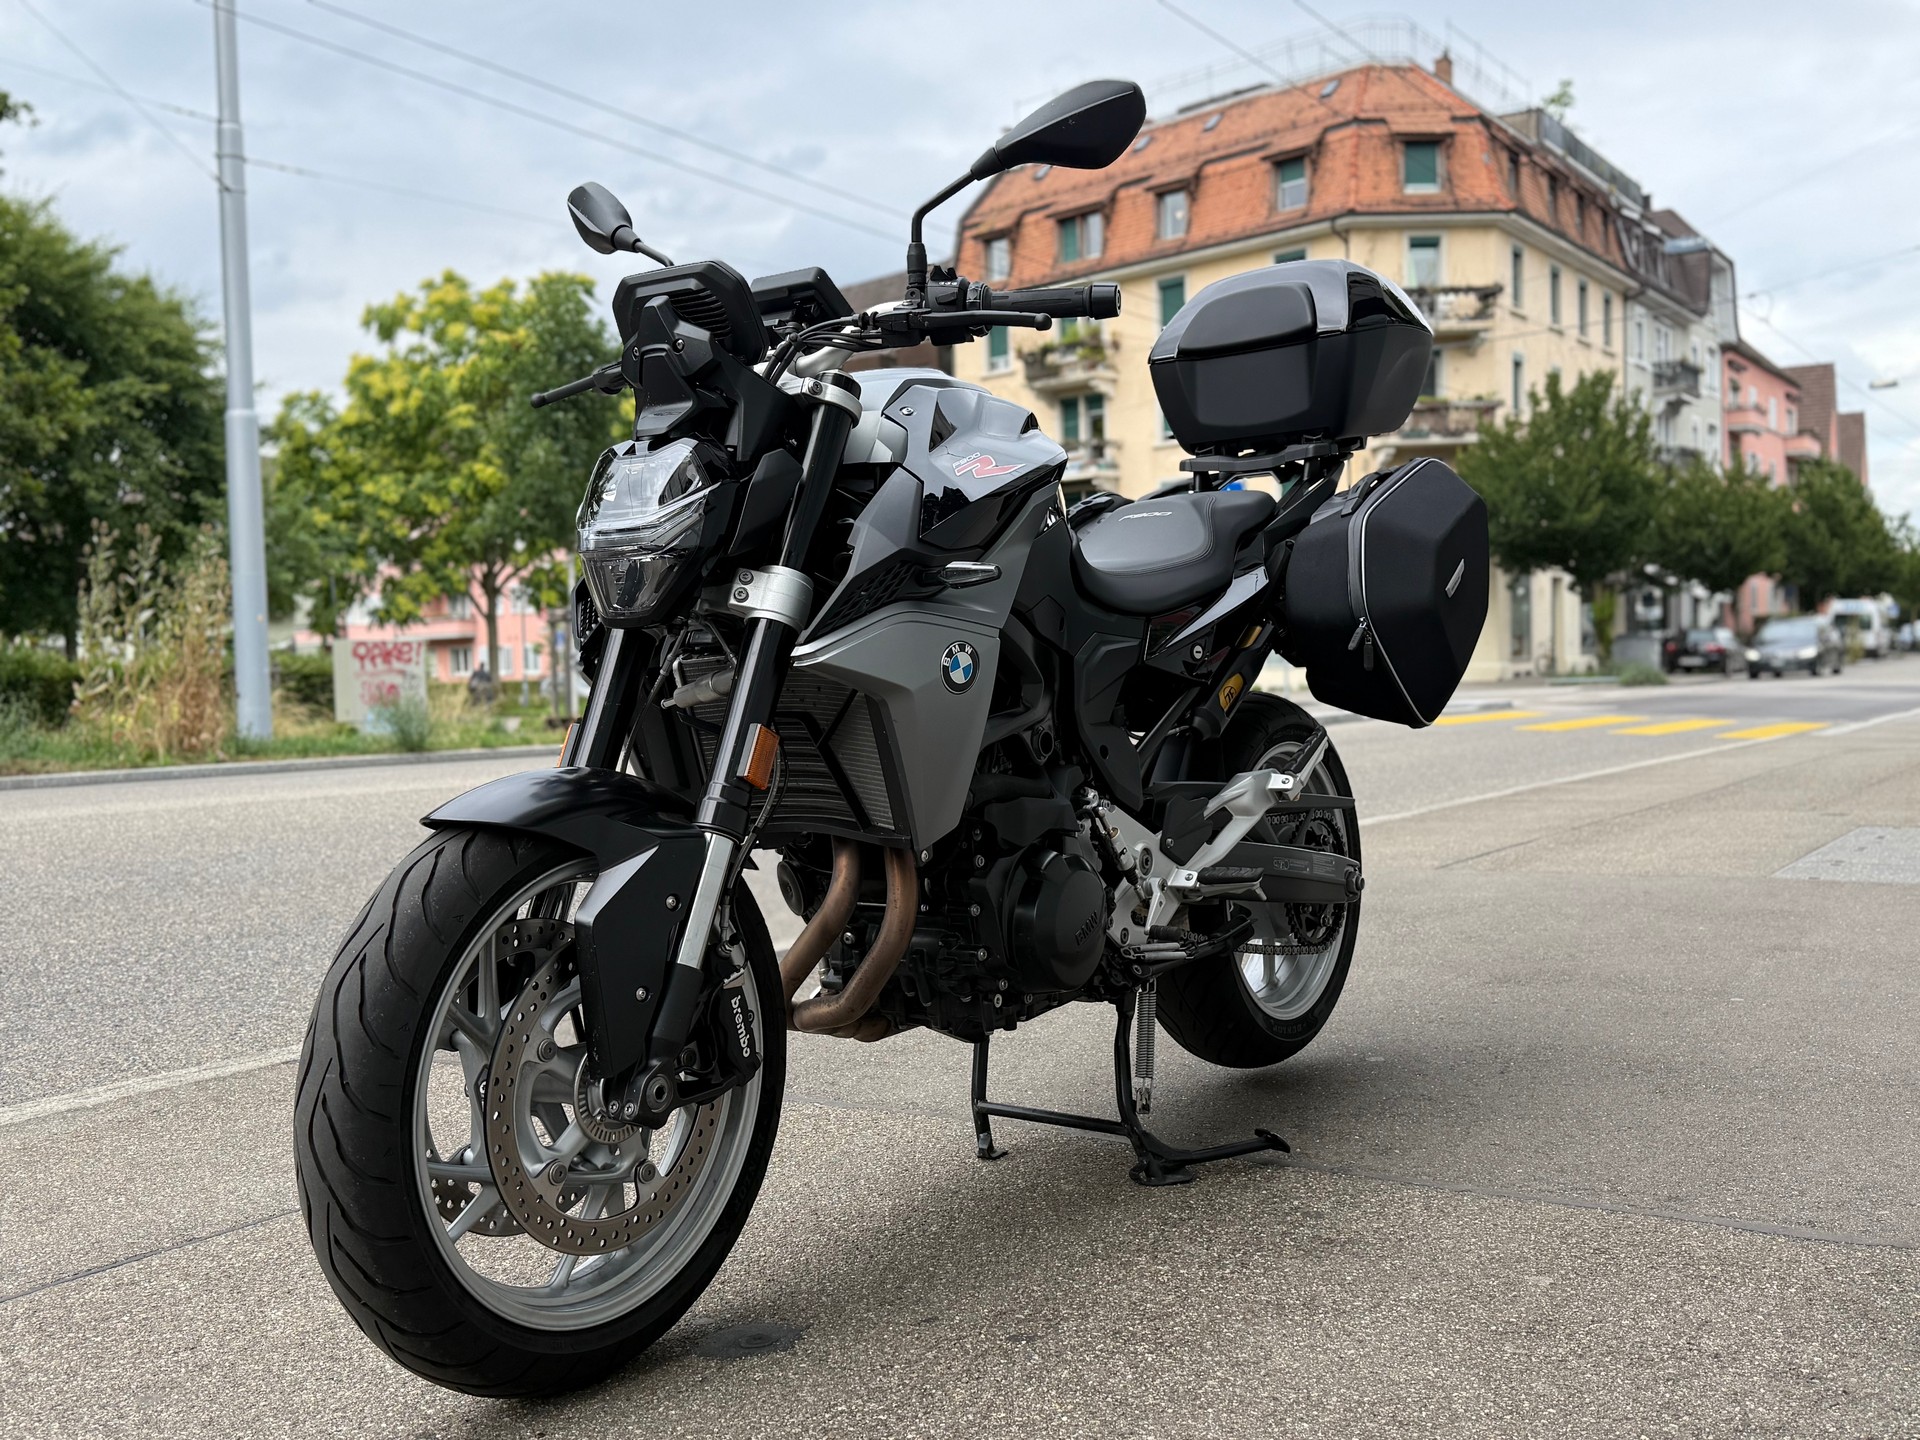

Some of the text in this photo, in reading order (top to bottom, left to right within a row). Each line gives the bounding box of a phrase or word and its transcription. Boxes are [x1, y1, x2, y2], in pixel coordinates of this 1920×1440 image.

[952, 452, 981, 469] F900
[954, 454, 1026, 479] R
[943, 644, 973, 667] BMW
[1074, 909, 1098, 946] BMW
[731, 995, 751, 1058] brembo
